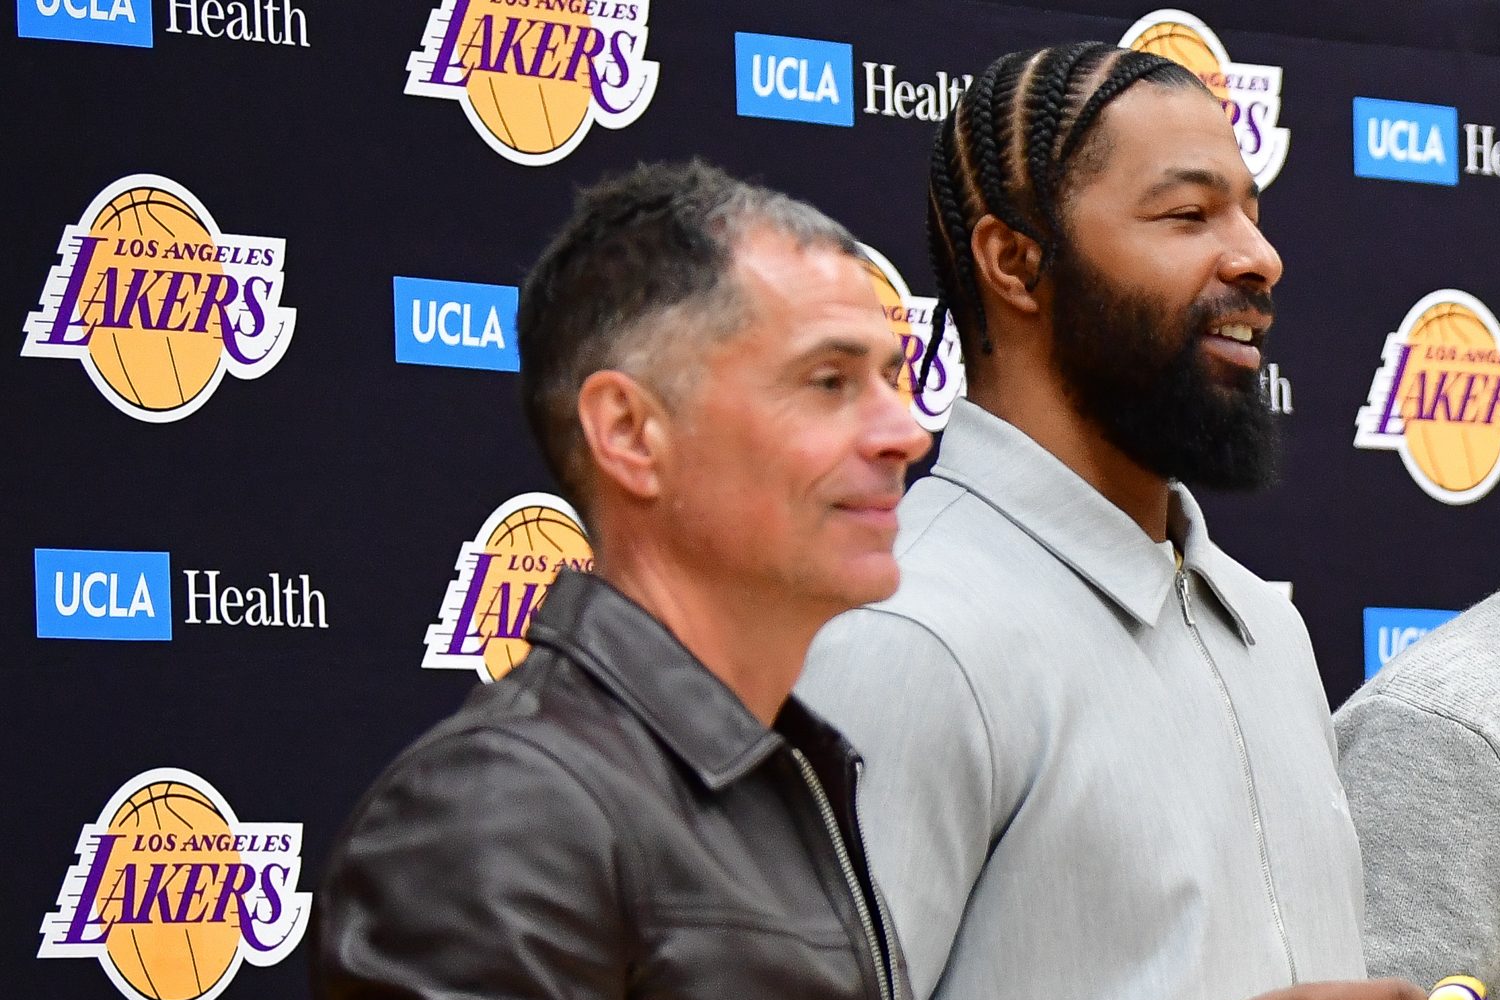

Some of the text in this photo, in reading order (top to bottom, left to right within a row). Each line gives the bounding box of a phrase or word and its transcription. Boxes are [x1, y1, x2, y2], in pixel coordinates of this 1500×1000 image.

[166, 0, 310, 47] Health
[534, 0, 638, 21] ANGELES
[418, 0, 647, 114] LAKERS
[752, 54, 974, 122] UCLA Healt
[1199, 72, 1270, 91] GELES
[1367, 117, 1446, 164] UCLA
[114, 238, 274, 266] LOS ANGELES
[36, 236, 284, 364] LAKERS
[411, 299, 504, 348] UCLA
[508, 555, 548, 572] LOS
[55, 569, 329, 628] UCLA Health
[435, 553, 552, 656] LAK
[1378, 626, 1428, 664] UC
[132, 834, 292, 852] LOS ANGELES
[52, 834, 301, 951] LAKERS
